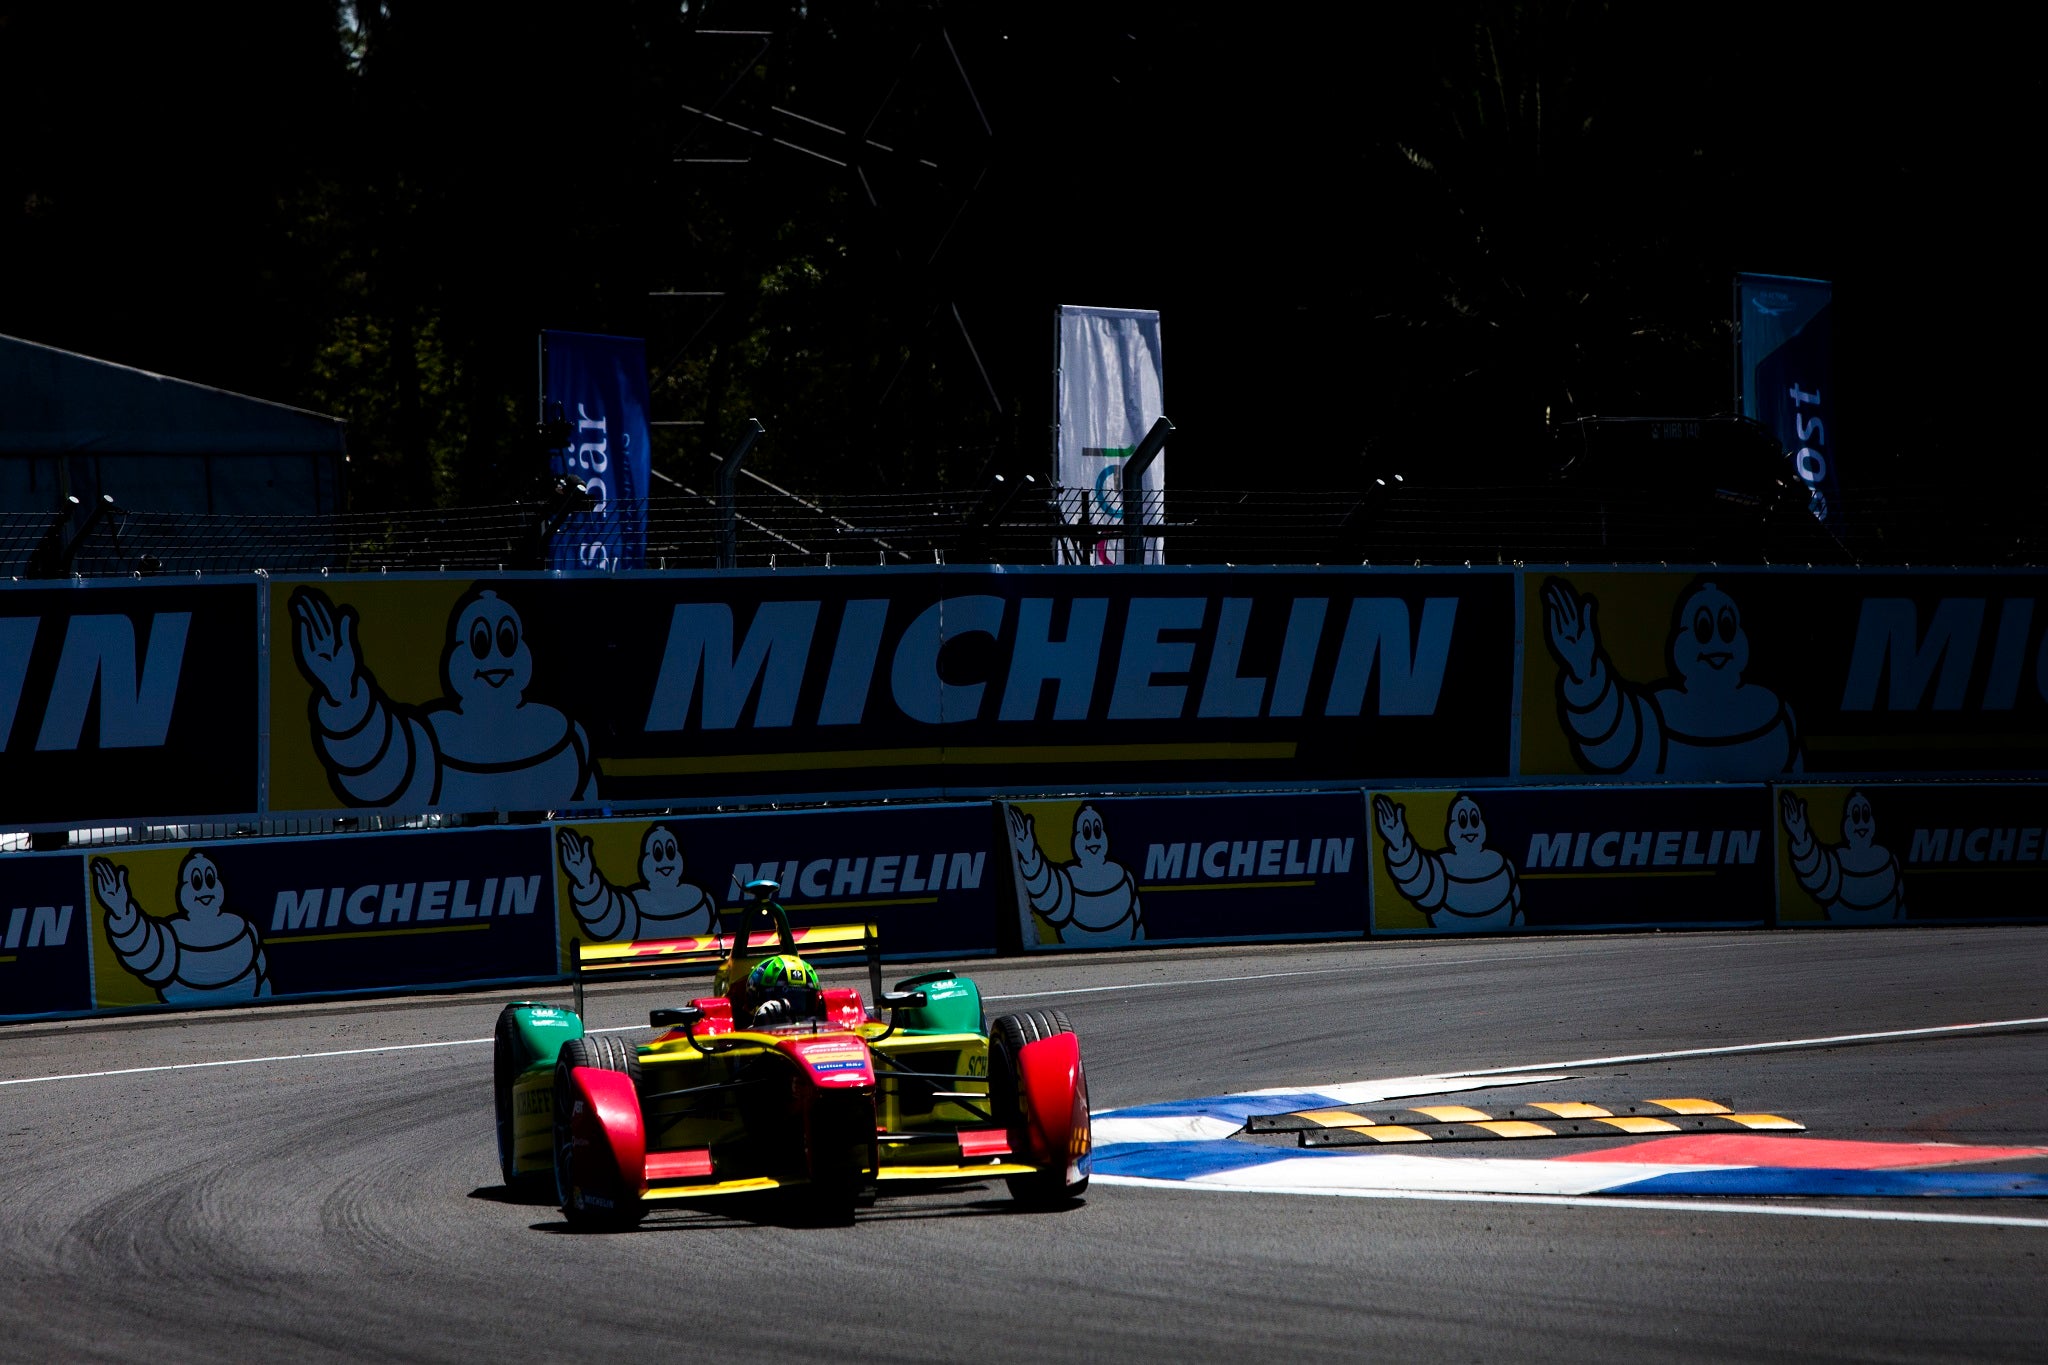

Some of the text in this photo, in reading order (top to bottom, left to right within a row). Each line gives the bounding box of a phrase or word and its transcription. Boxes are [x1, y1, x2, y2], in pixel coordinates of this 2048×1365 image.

[643, 595, 1460, 732] MICHELIN
[1839, 595, 2048, 713] MI
[1144, 837, 1355, 880] MICHELIN
[1526, 829, 1762, 868] MICHELIN
[1908, 826, 2048, 864] MICHE
[725, 851, 988, 901] MICHELIN
[271, 875, 542, 931] MICHELIN
[0, 905, 74, 949] IN
